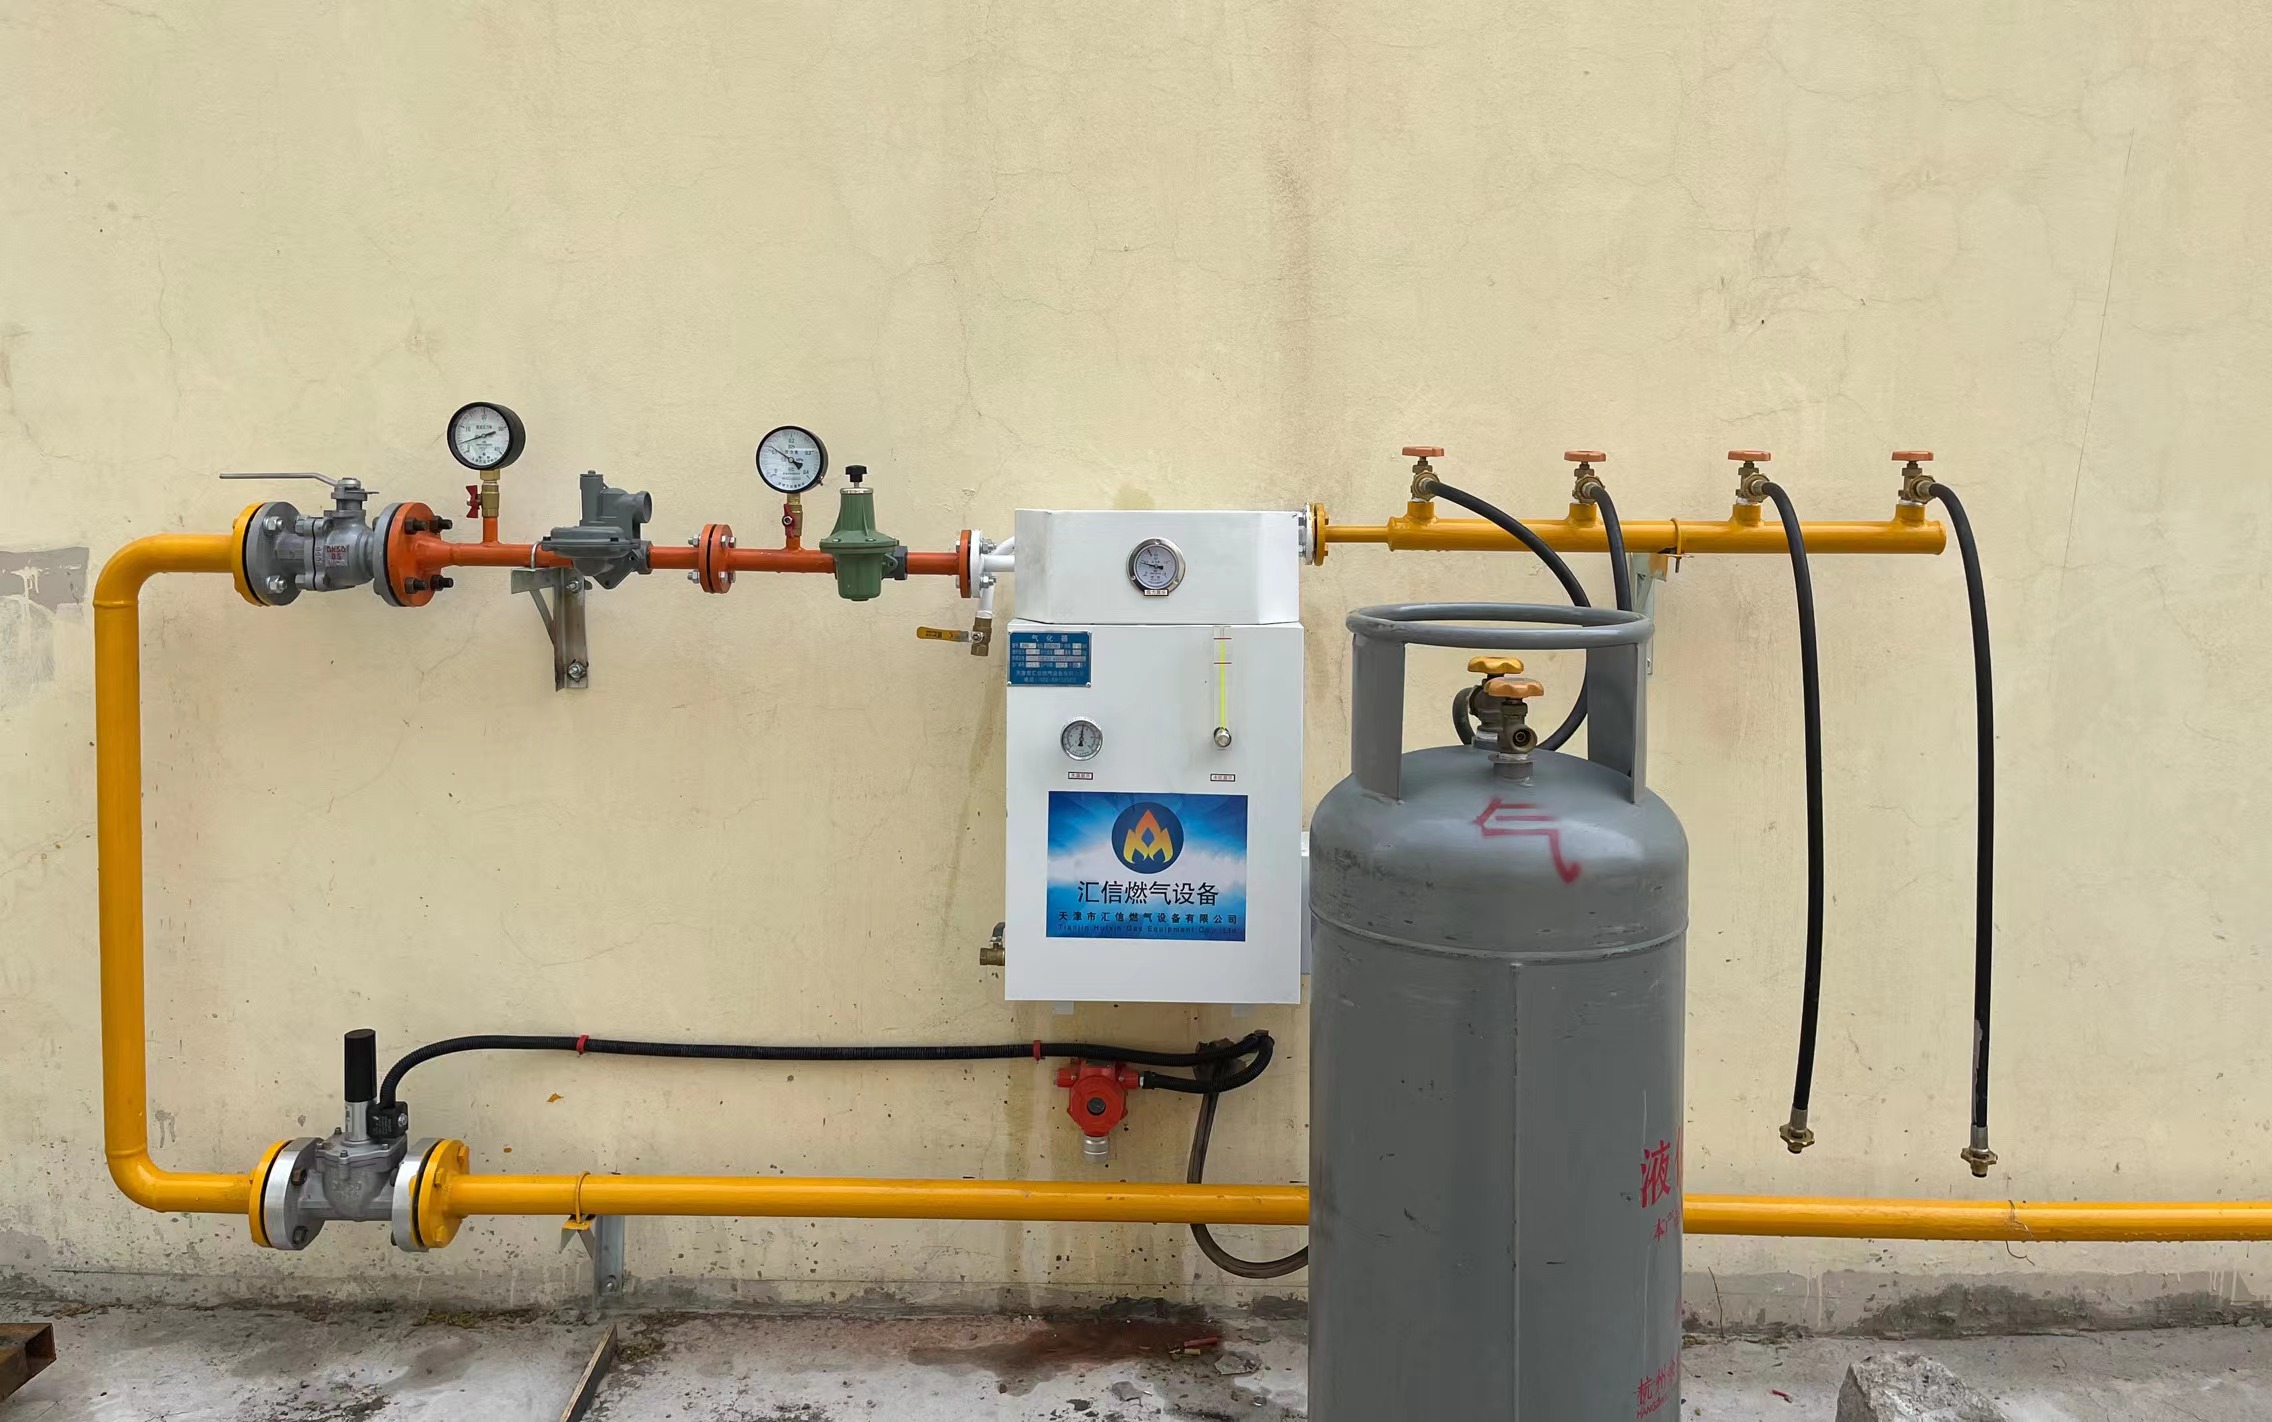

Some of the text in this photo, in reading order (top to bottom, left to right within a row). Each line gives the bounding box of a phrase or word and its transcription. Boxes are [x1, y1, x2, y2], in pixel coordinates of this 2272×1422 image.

[1077, 880, 1220, 906] 汇信燃气设备
[1058, 911, 1238, 925] 天津市汇信燃气设备有限公司
[1058, 923, 1089, 932] Tianjin
[1147, 925, 1195, 934] Equipment
